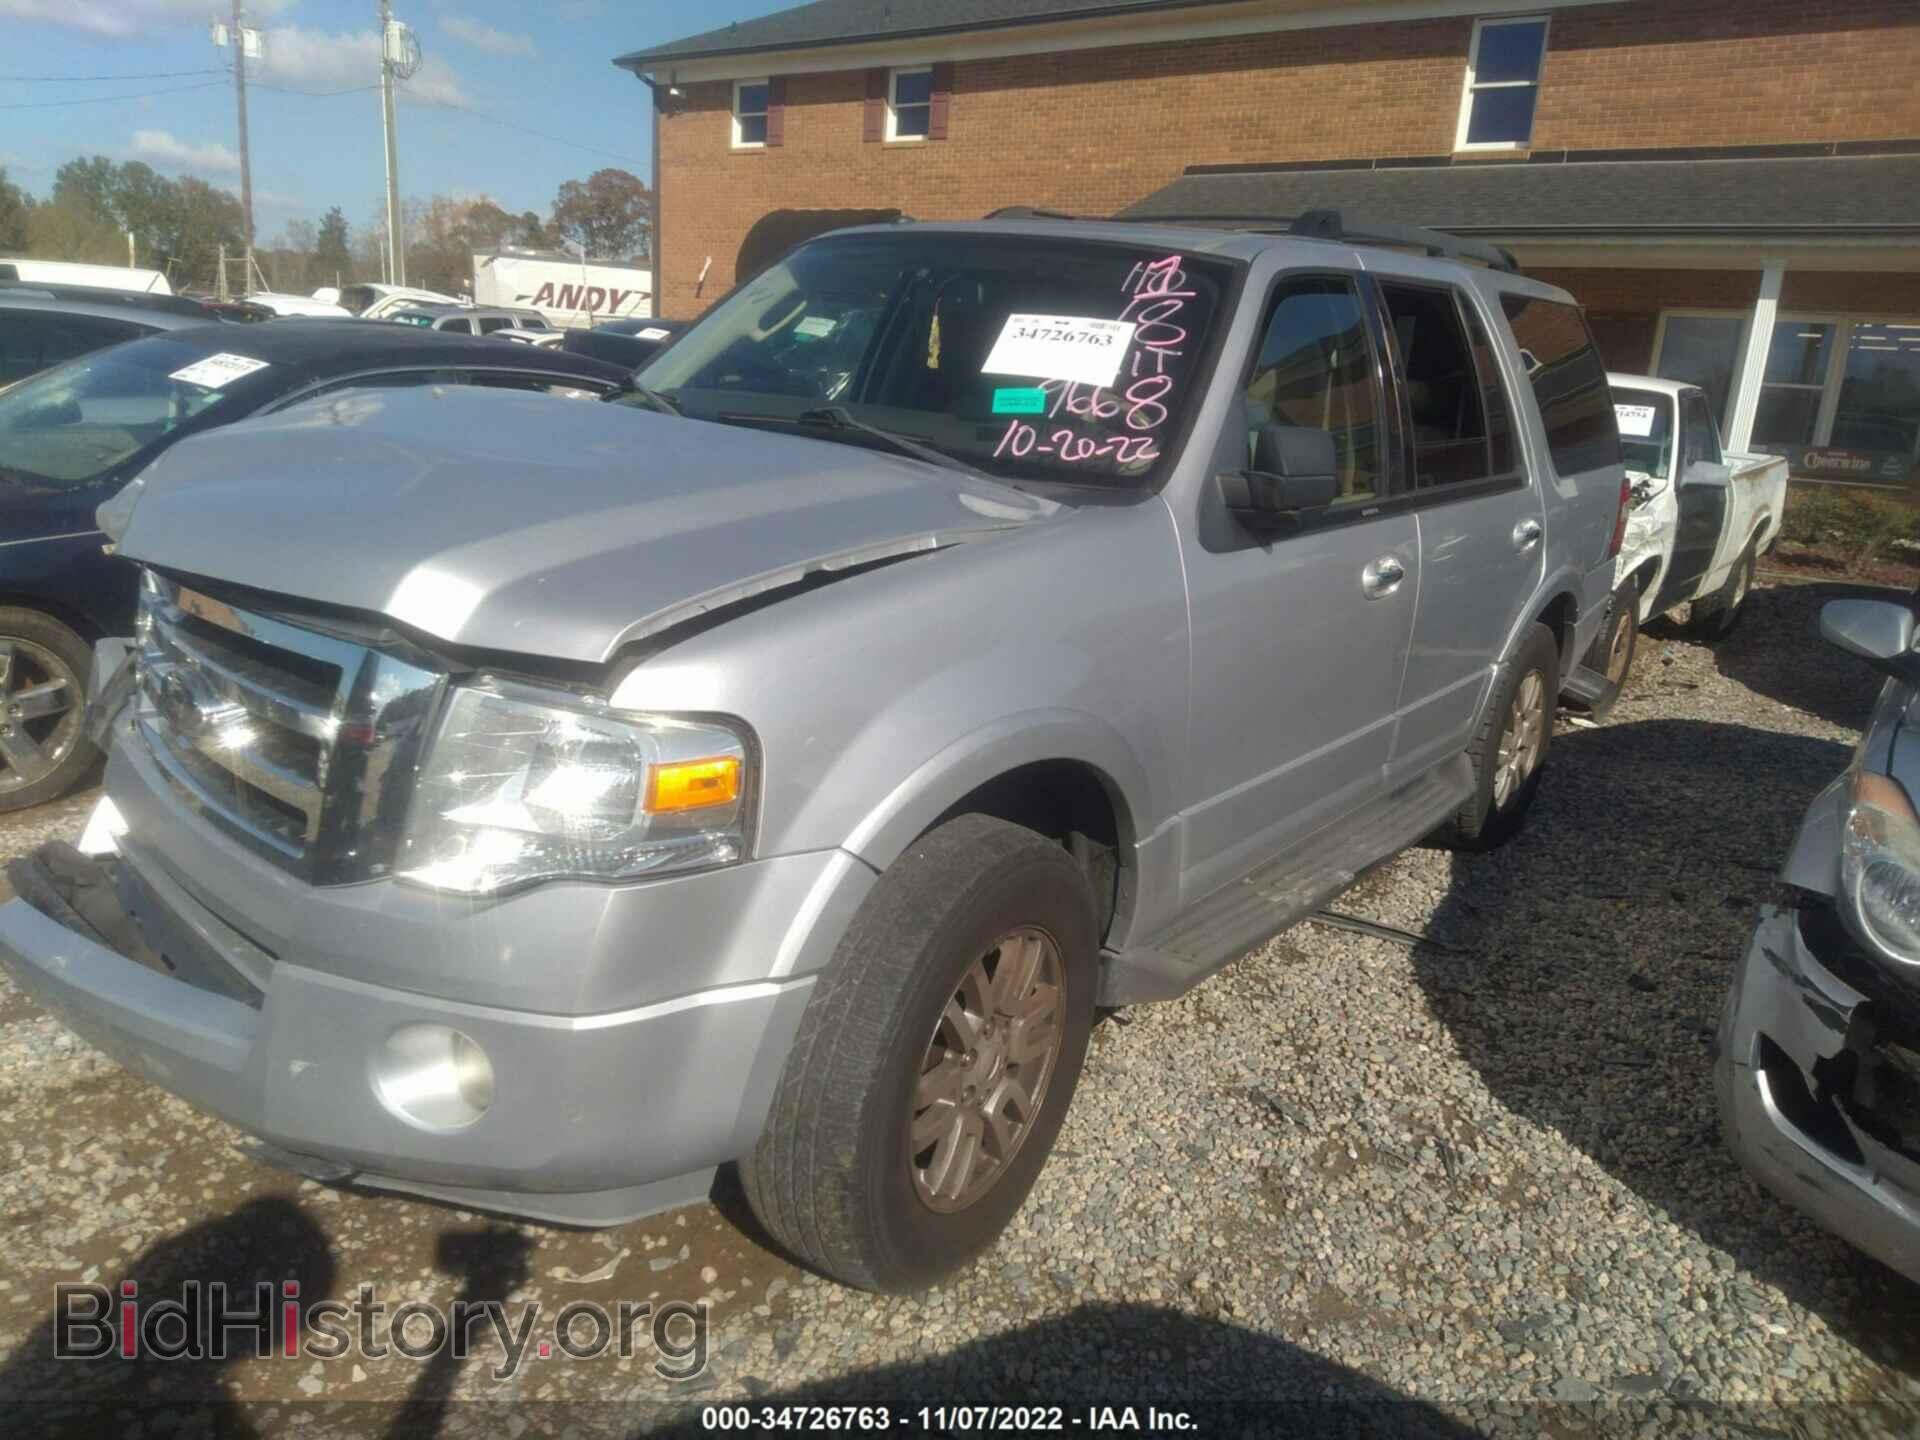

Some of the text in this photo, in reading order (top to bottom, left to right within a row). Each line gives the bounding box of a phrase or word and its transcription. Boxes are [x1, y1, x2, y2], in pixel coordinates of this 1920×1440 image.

[531, 282, 634, 314] ANDY
[1012, 326, 1113, 347] 34726763
[993, 419, 1161, 463] 10-20-22
